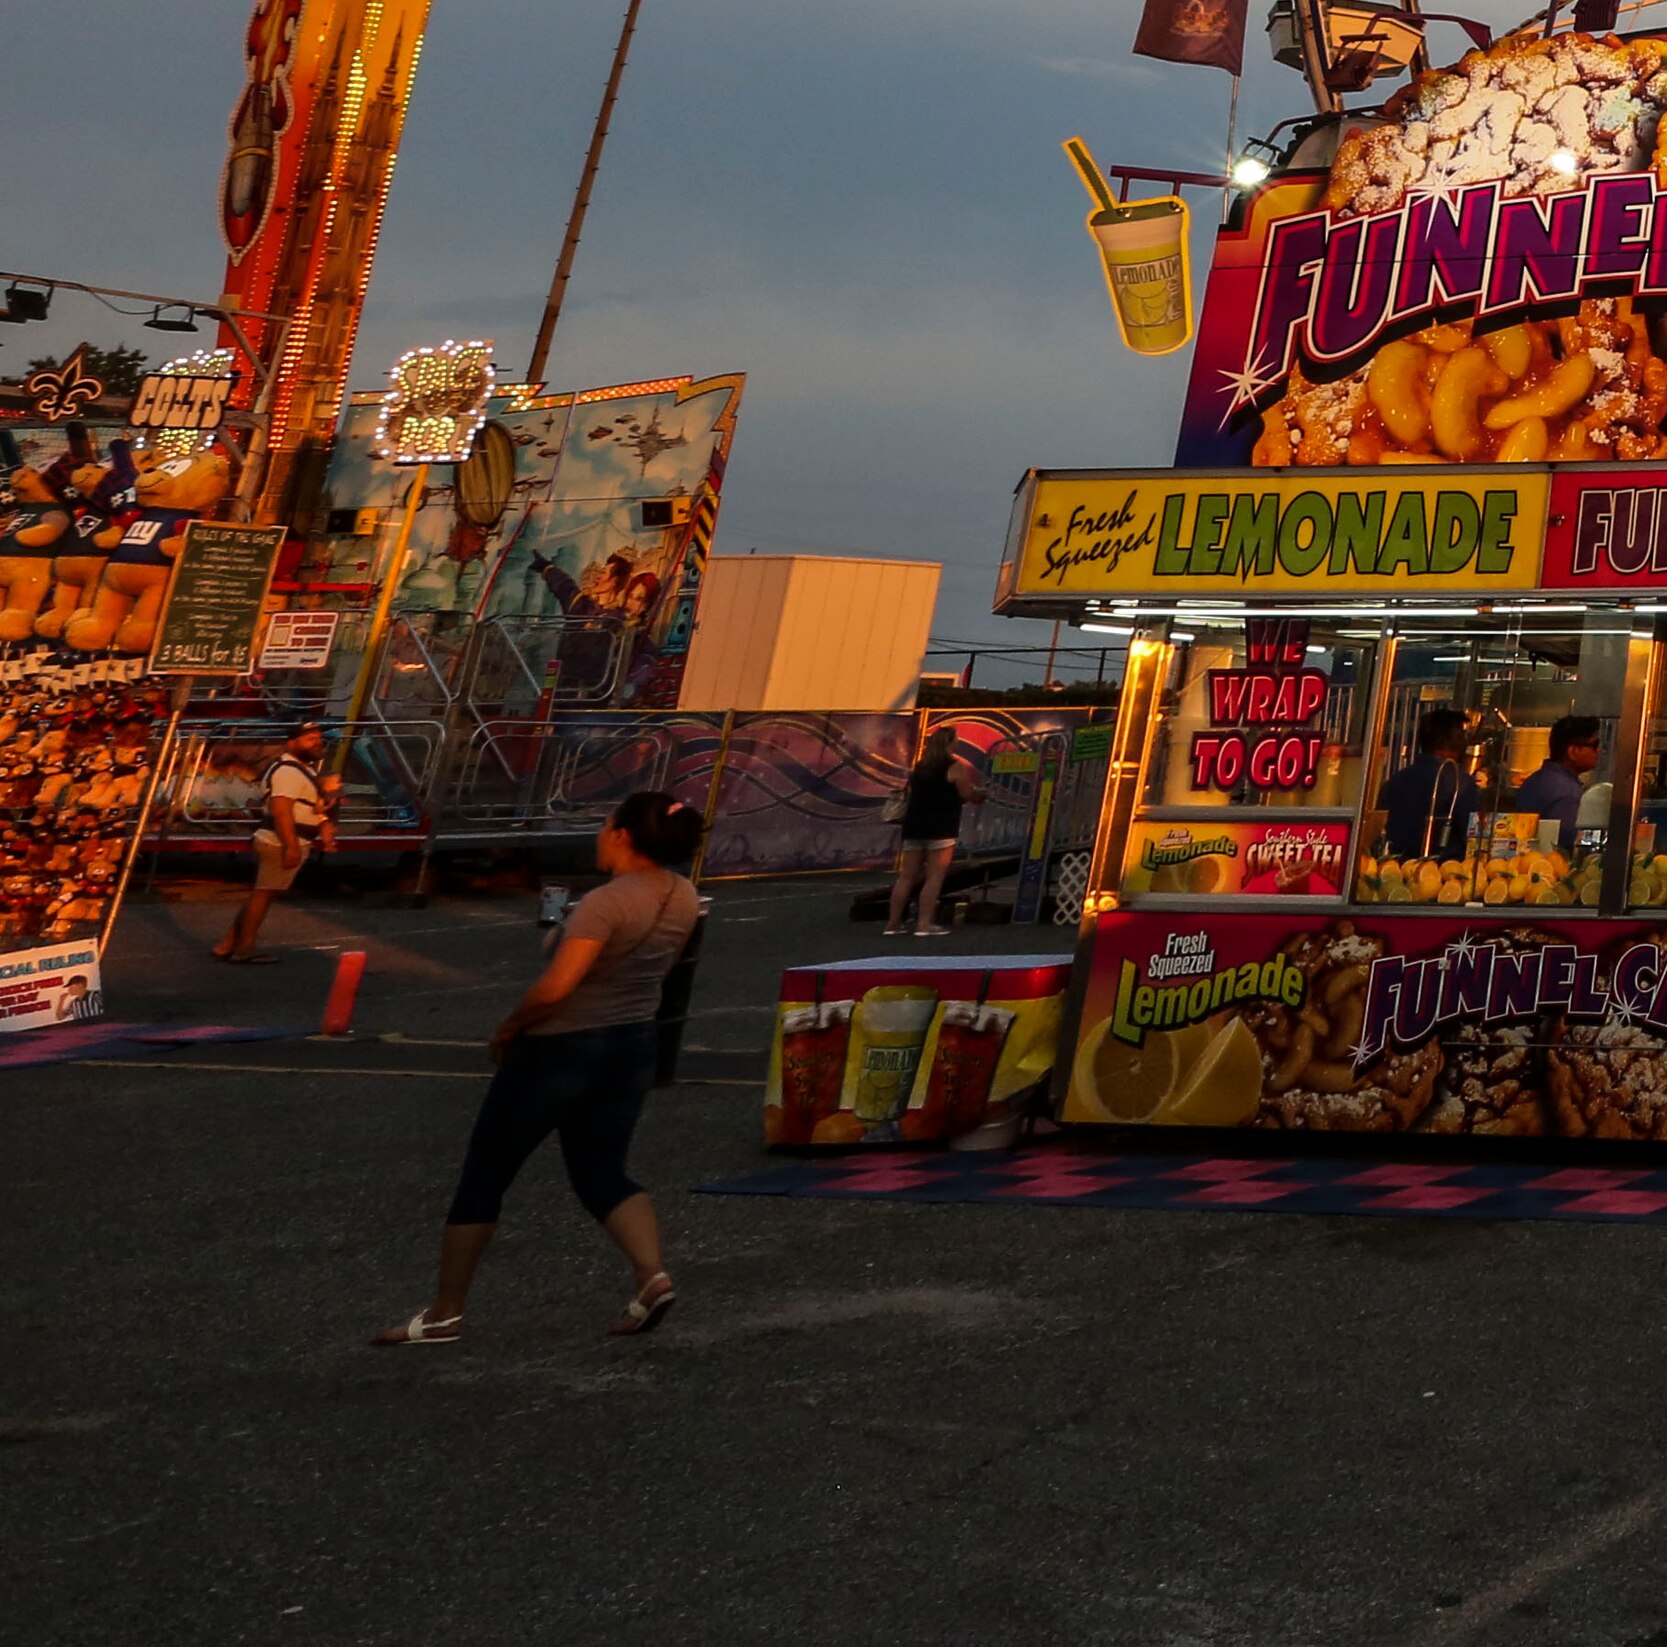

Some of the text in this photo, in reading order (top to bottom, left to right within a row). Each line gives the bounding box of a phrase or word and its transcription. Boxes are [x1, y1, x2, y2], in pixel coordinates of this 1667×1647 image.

[130, 376, 232, 428] COLTS
[1065, 489, 1138, 545] Fresh
[1153, 490, 1518, 583] LEMONADE
[1040, 514, 1156, 584] Squeezed
[160, 644, 173, 661] 3
[174, 643, 209, 662] BALLS
[212, 640, 230, 663] for
[1250, 618, 1306, 663] WE
[1212, 676, 1326, 722] WRAP
[1195, 737, 1321, 787] TO GO!
[1142, 836, 1237, 870] Lemonade
[1247, 844, 1343, 865] SWEET TEA
[1265, 828, 1327, 846] Southern Style
[39, 951, 95, 972] RULING
[1148, 950, 1214, 979] Squeezed
[1165, 930, 1207, 955] Fresh
[1113, 953, 1303, 1043] Lemonade
[1362, 944, 1608, 1057] FUNNEL
